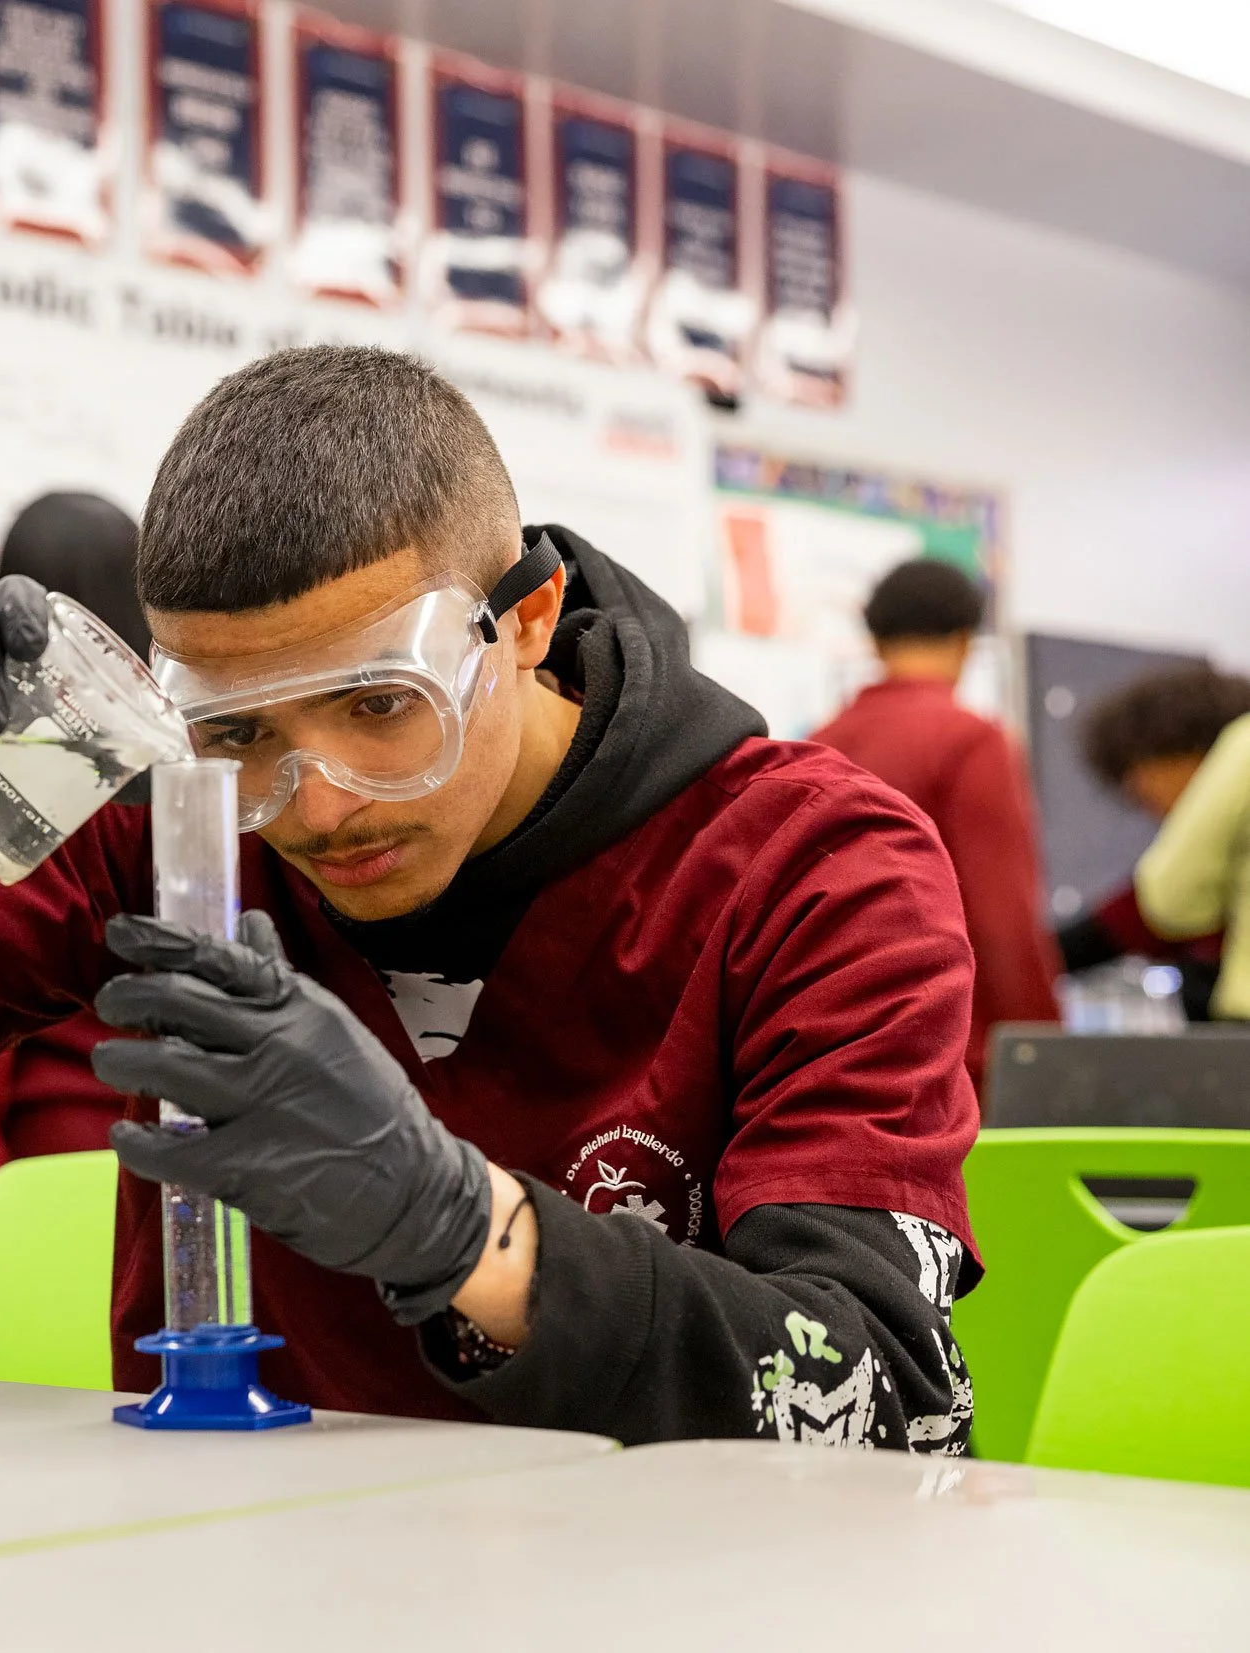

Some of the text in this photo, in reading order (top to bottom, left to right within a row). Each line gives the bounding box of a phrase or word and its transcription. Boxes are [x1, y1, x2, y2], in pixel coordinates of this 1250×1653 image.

[580, 1125, 620, 1162] Richard
[622, 1124, 684, 1167] Izquierdo
[687, 1182, 702, 1236] SCHOOL
